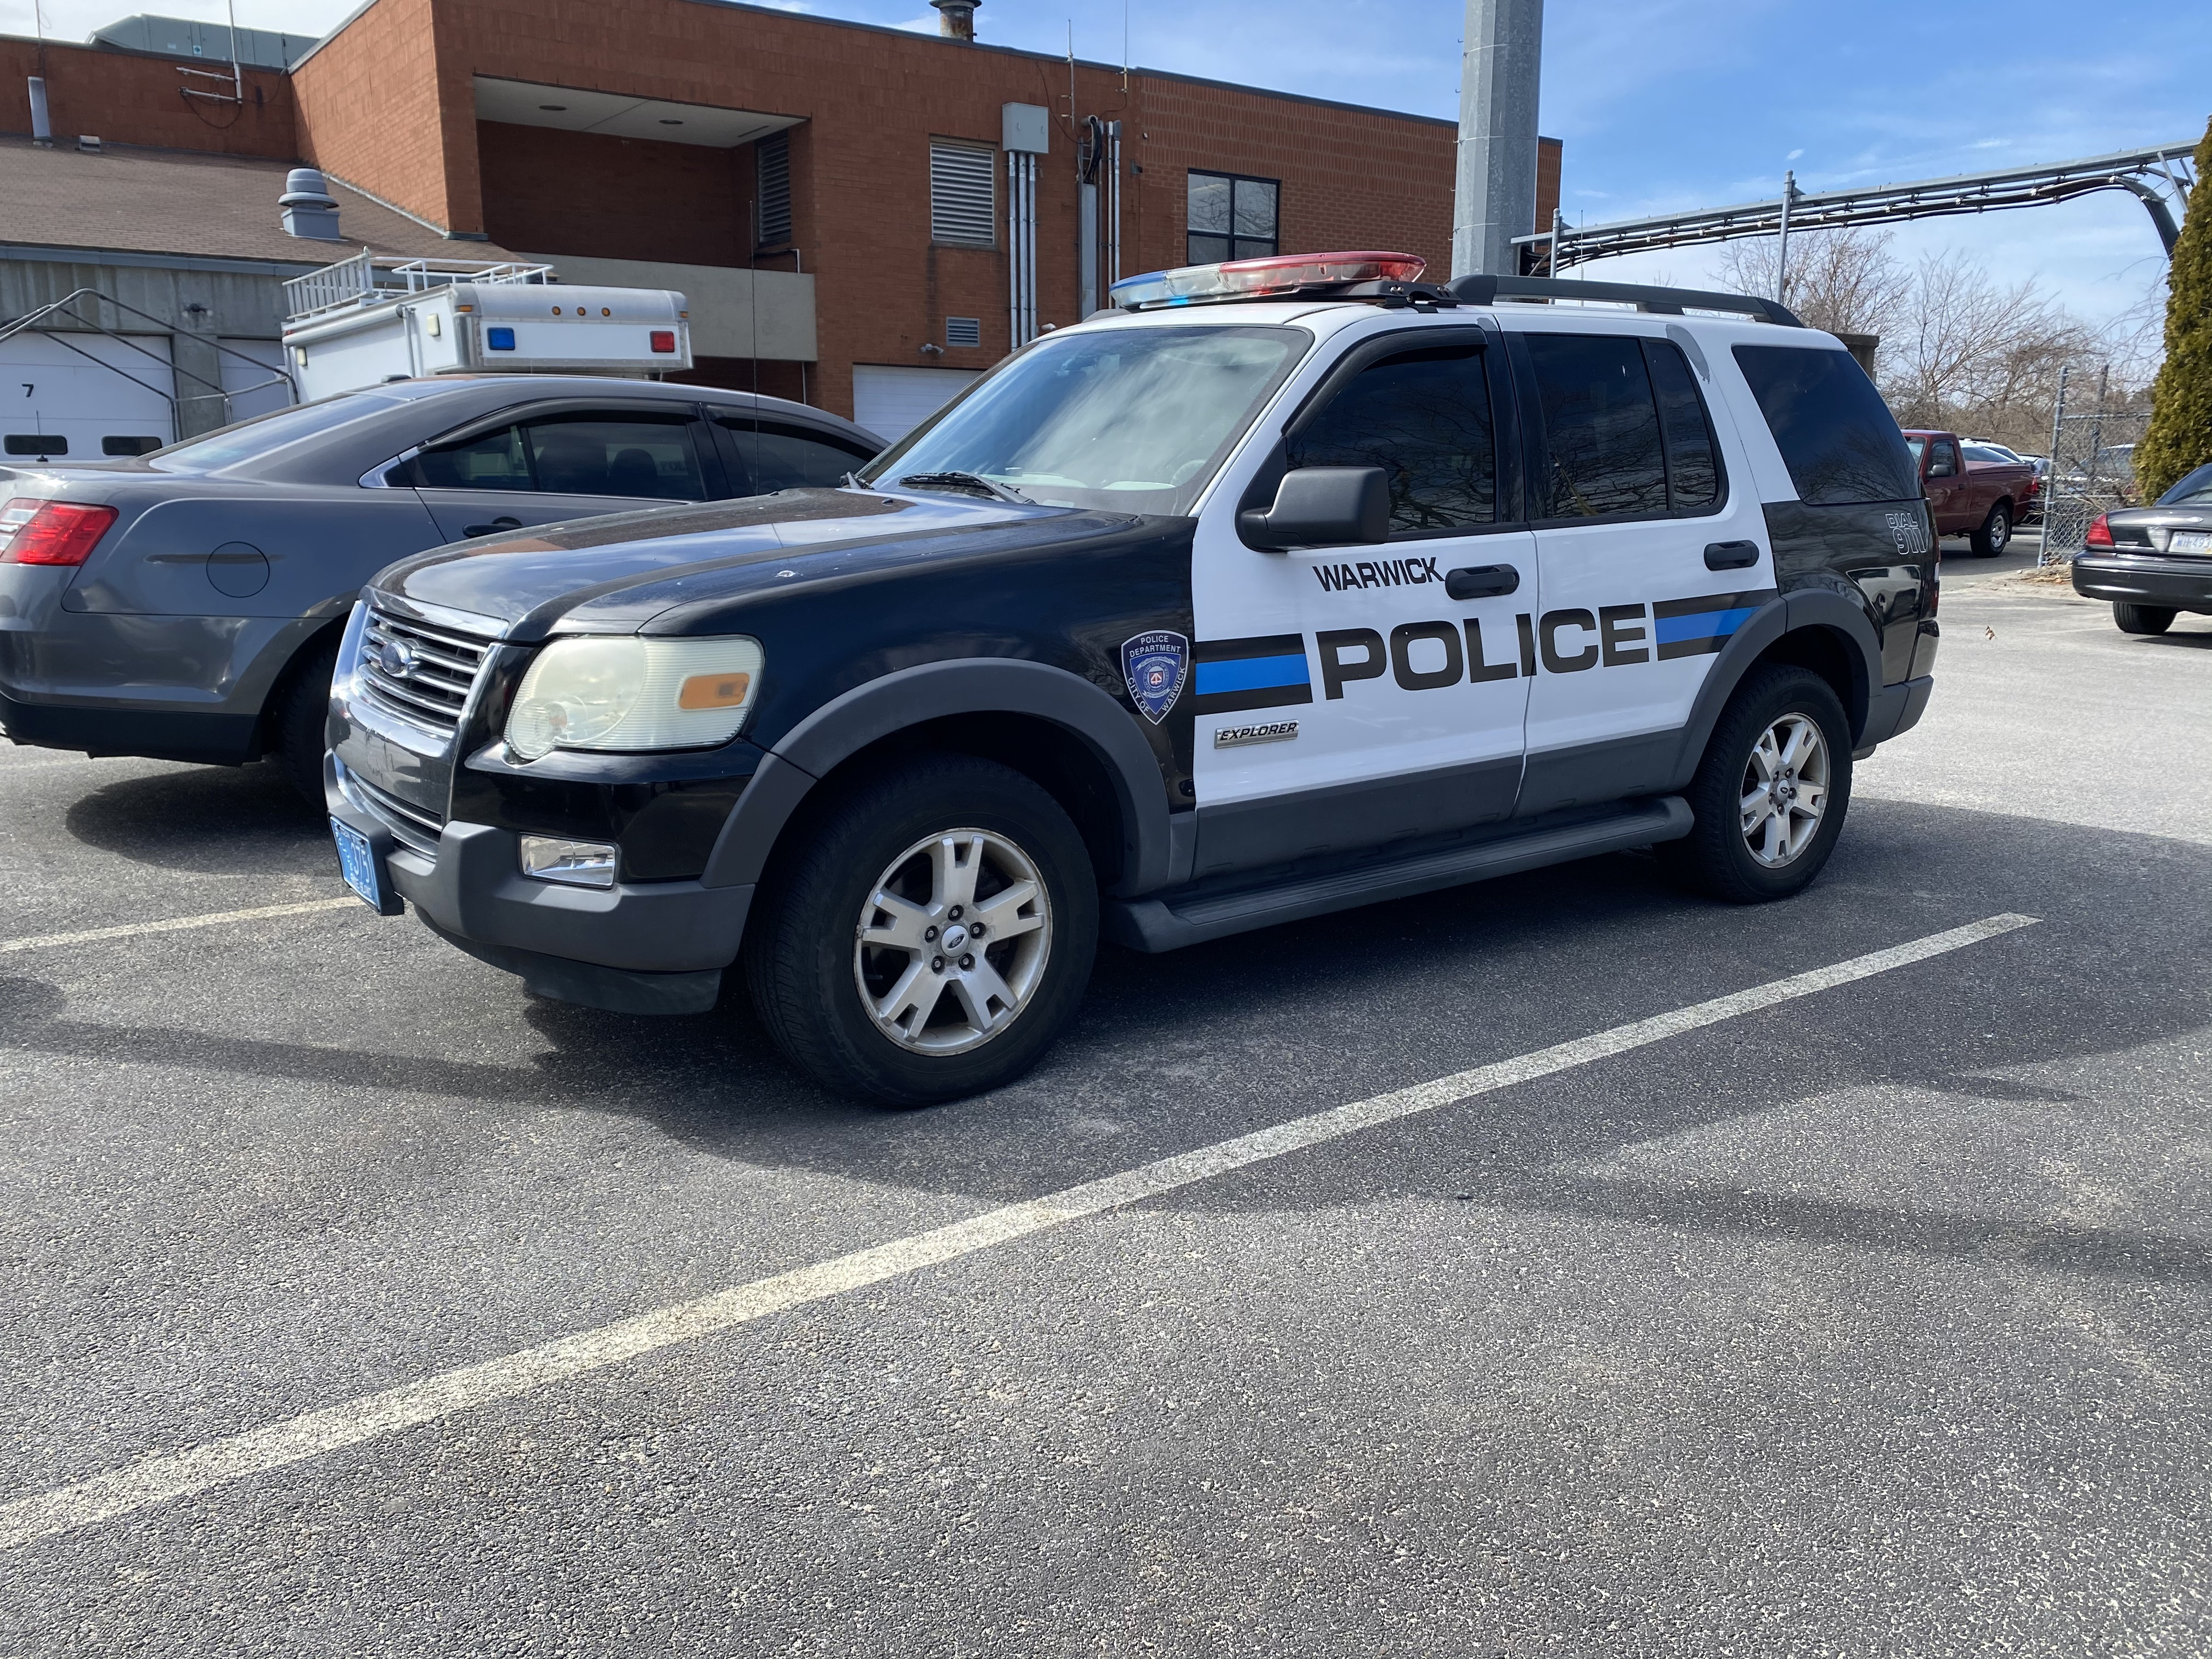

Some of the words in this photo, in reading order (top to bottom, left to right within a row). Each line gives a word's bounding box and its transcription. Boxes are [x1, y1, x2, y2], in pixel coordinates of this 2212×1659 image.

[21, 383, 34, 397] 7
[1885, 513, 1918, 528] DIAL
[1893, 527, 1927, 555] 911
[1312, 557, 1446, 592] WARWICK
[1141, 635, 1169, 645] POLICE
[1129, 644, 1181, 658] DEPARTMENT
[1315, 602, 1650, 700] POLICE
[1128, 677, 1141, 699] CITY
[1139, 701, 1150, 712] OF
[1161, 667, 1185, 711] WARWICK
[1219, 722, 1297, 741] EXPLORER
